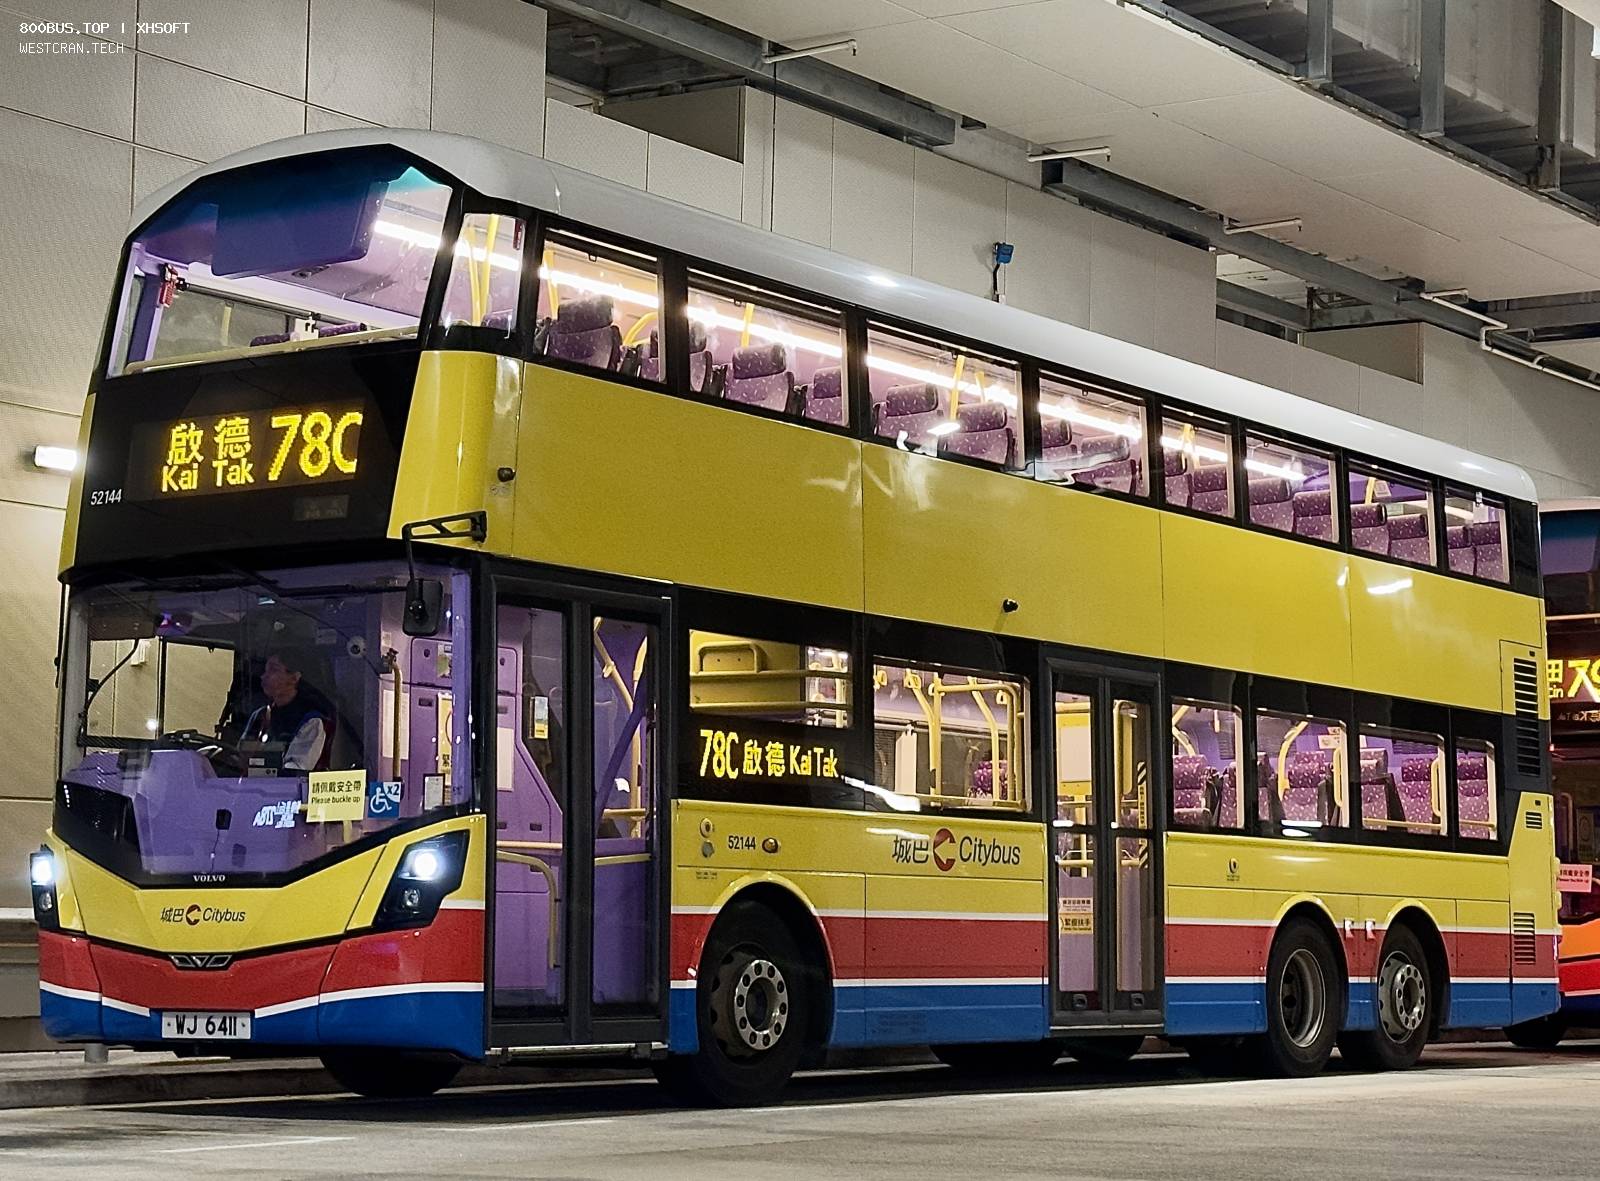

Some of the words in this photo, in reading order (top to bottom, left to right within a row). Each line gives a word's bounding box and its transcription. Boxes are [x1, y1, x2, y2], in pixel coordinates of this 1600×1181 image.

[267, 411, 363, 481] 78C
[161, 463, 199, 492] Kai
[212, 457, 255, 487] Tak
[90, 488, 122, 506] 52144
[700, 729, 739, 779] 78C
[789, 745, 811, 776] Kai
[813, 747, 839, 778] Tak
[311, 796, 330, 804] Please
[332, 795, 351, 804] buckle
[728, 835, 756, 850] 52144
[892, 835, 929, 864] 城巴
[959, 836, 1021, 866] Citybus
[193, 874, 226, 882] VOLVO
[160, 907, 184, 923] 城巴
[203, 907, 246, 923] Citybus
[175, 1014, 198, 1035] WJ
[205, 1016, 237, 1036] 6411
